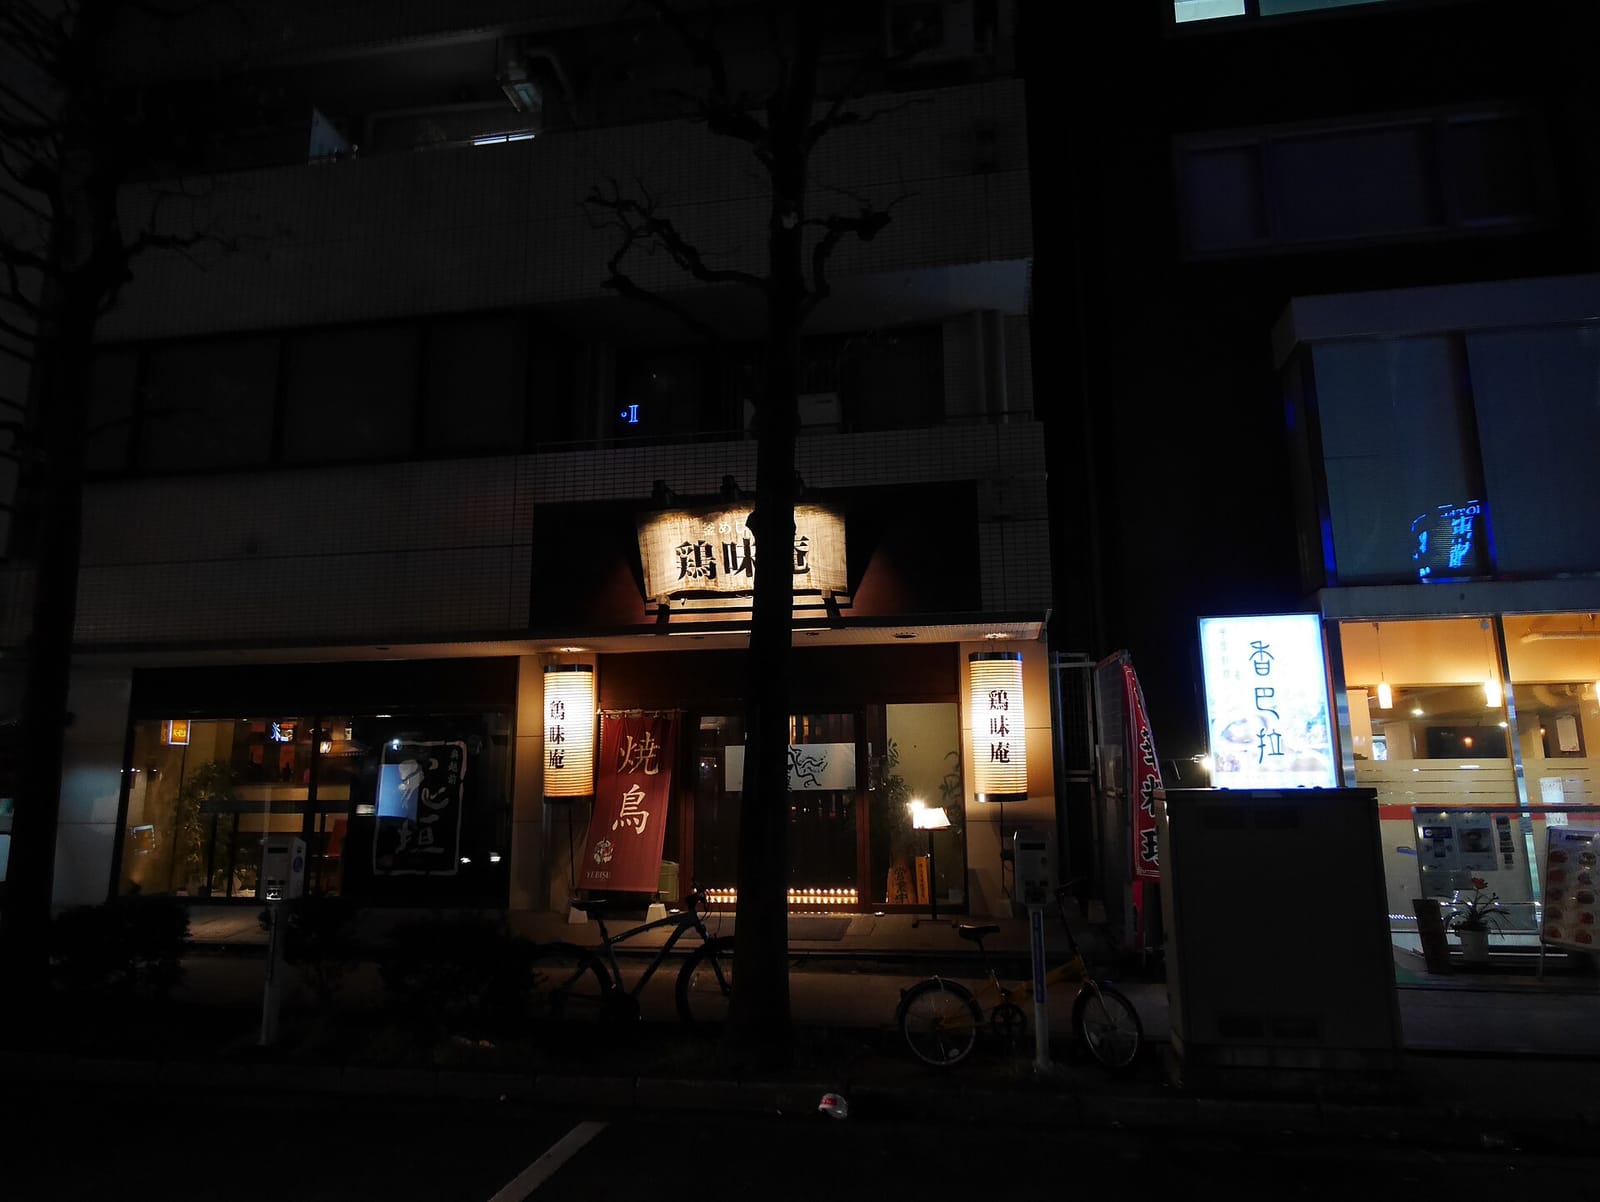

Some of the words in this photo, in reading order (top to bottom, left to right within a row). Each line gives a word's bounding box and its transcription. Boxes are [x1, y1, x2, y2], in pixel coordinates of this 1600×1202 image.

[986, 689, 1010, 763] 鶏味庵
[1248, 640, 1285, 764] 香巴拉
[611, 731, 661, 835] 焼鳥
